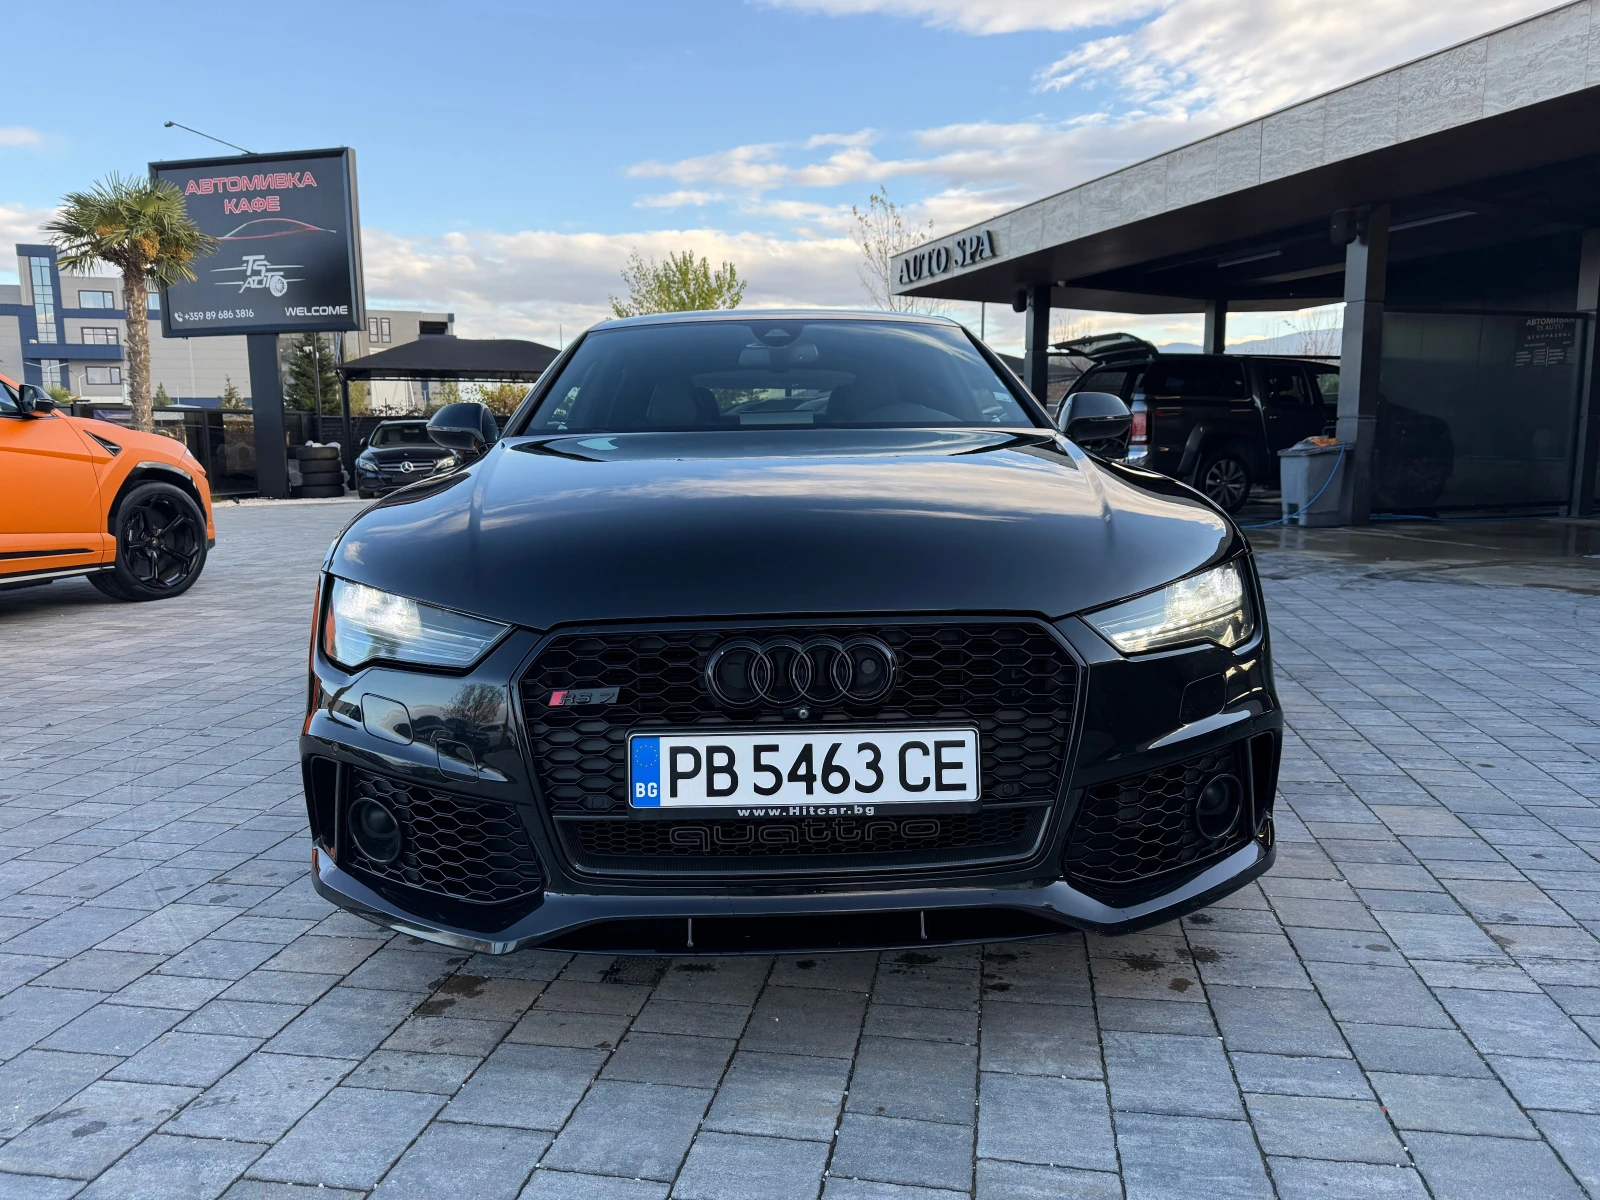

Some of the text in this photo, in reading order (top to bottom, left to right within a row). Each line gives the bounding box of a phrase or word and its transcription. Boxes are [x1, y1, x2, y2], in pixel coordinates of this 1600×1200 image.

[185, 172, 317, 195] АВТОМИВКА
[224, 196, 280, 214] КАФЕ
[899, 230, 994, 284] AUTO SPA
[184, 308, 255, 321] +359 89 686 3816
[284, 305, 348, 317] WELCOME
[669, 740, 966, 798] PB 5463 CE
[635, 782, 658, 798] BG
[737, 805, 875, 816] www.Hitcar.bg
[669, 819, 940, 851] quattro
